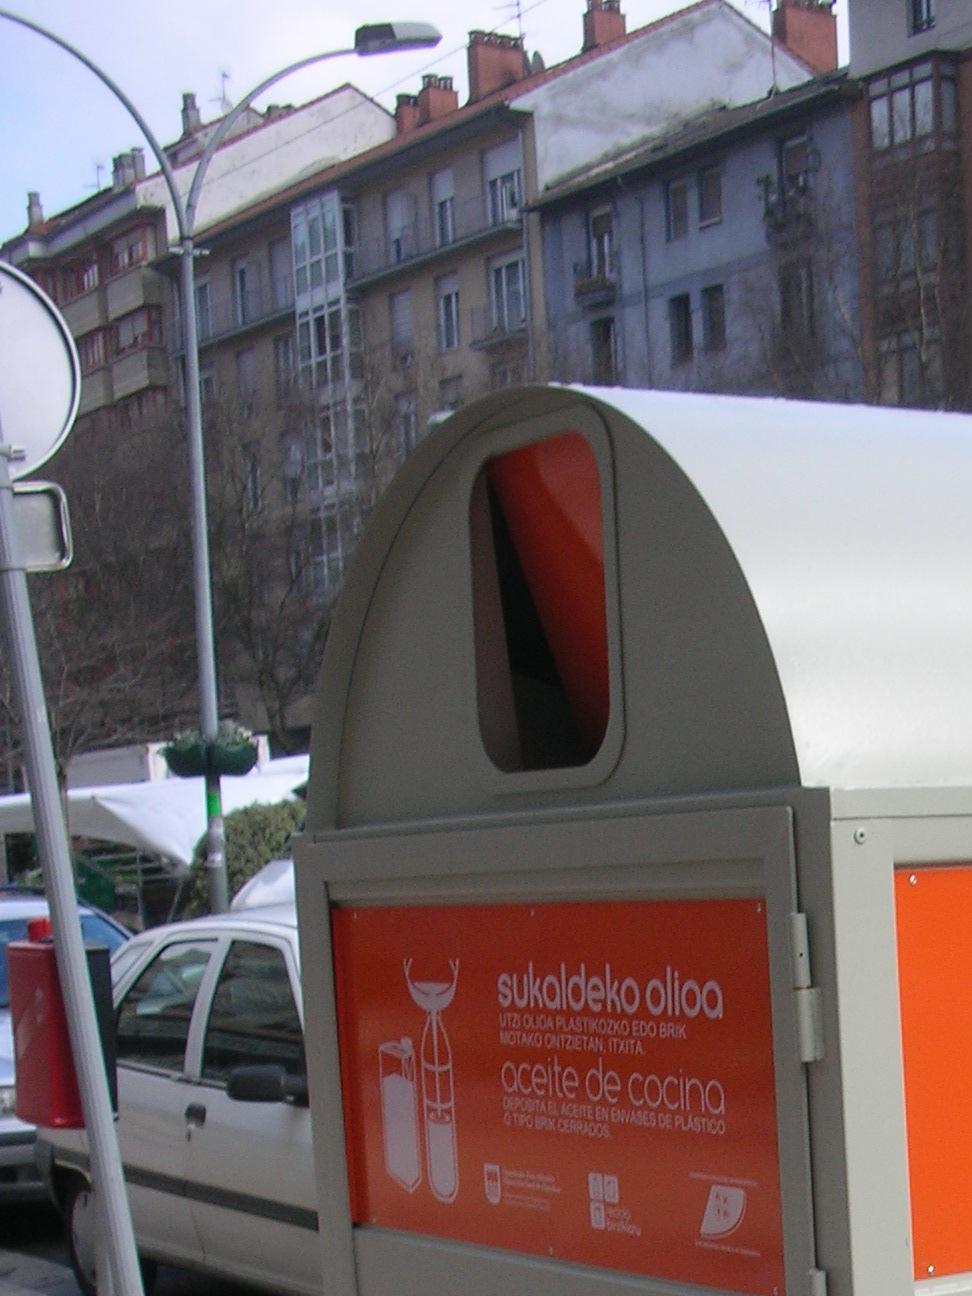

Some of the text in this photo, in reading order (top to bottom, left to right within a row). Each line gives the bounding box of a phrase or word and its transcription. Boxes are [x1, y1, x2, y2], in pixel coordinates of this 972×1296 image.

[497, 960, 723, 1019] sukaldeko olioa
[500, 1029, 543, 1048] MOTAKO
[556, 1015, 630, 1036] PLASTIKOZKO
[632, 1020, 658, 1038] EDO
[660, 1022, 687, 1040] BRIK
[501, 1055, 726, 1115] aceite de cocina
[610, 1107, 656, 1127] ENVASES
[658, 1112, 673, 1129] DE
